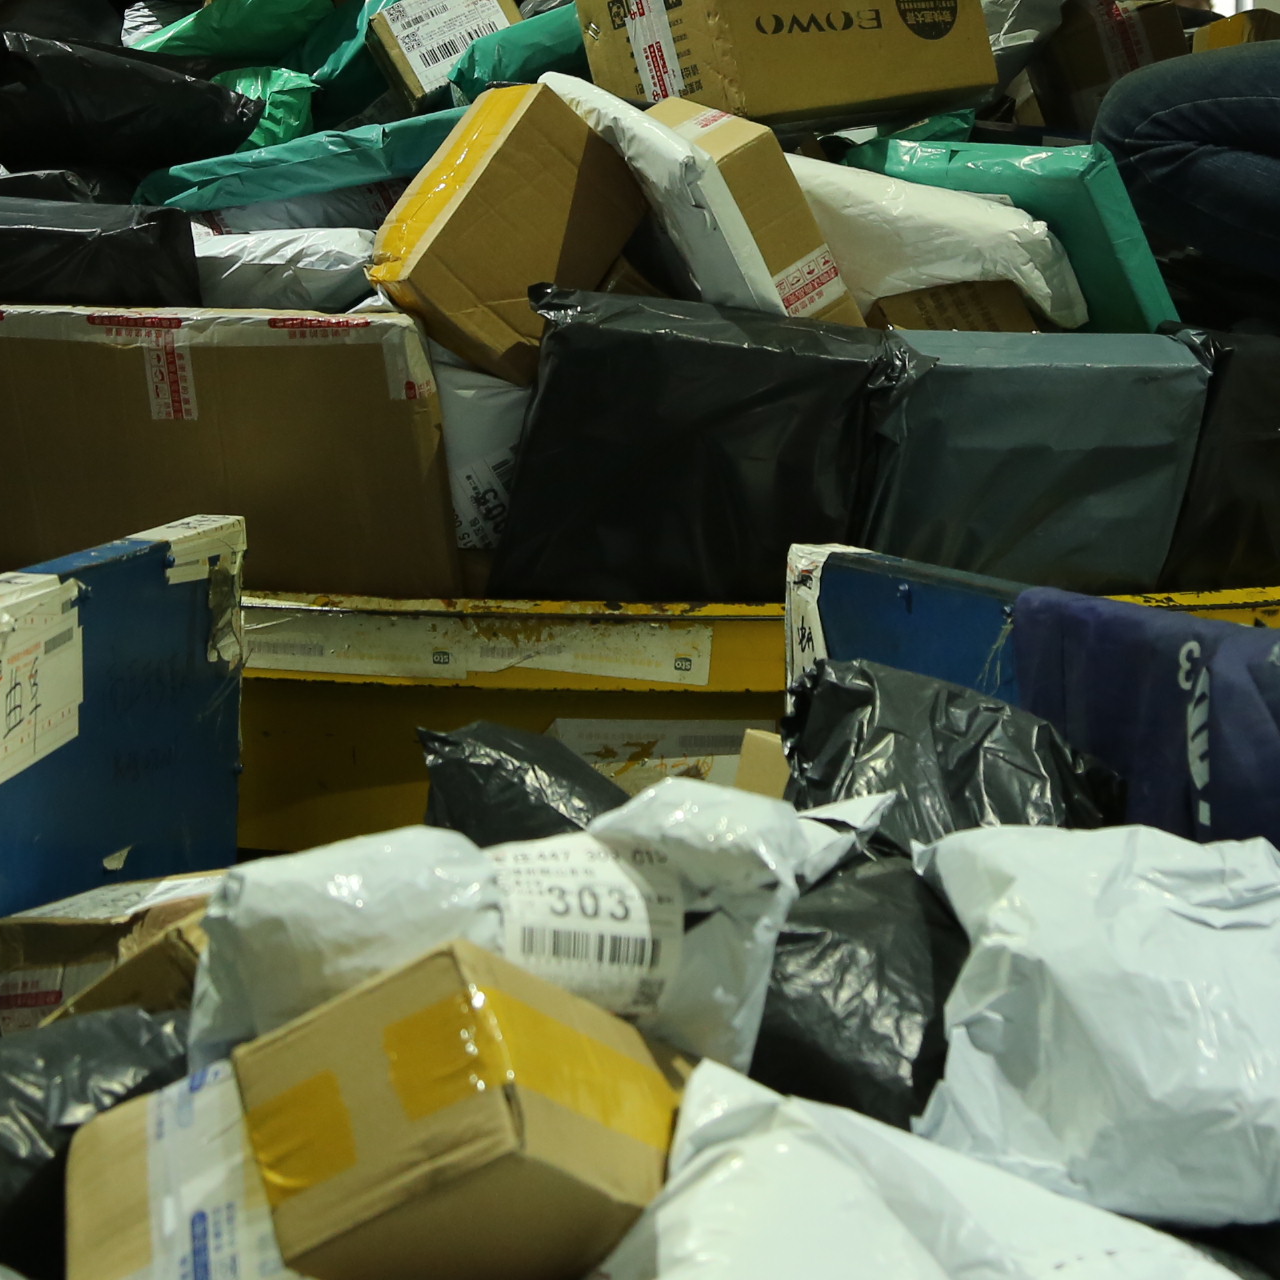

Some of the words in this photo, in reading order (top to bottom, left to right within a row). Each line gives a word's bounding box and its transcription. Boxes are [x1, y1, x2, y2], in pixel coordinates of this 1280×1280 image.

[755, 8, 883, 35] BOWO
[432, 651, 450, 665] sto
[674, 657, 692, 672] sto
[548, 884, 630, 921] 303
